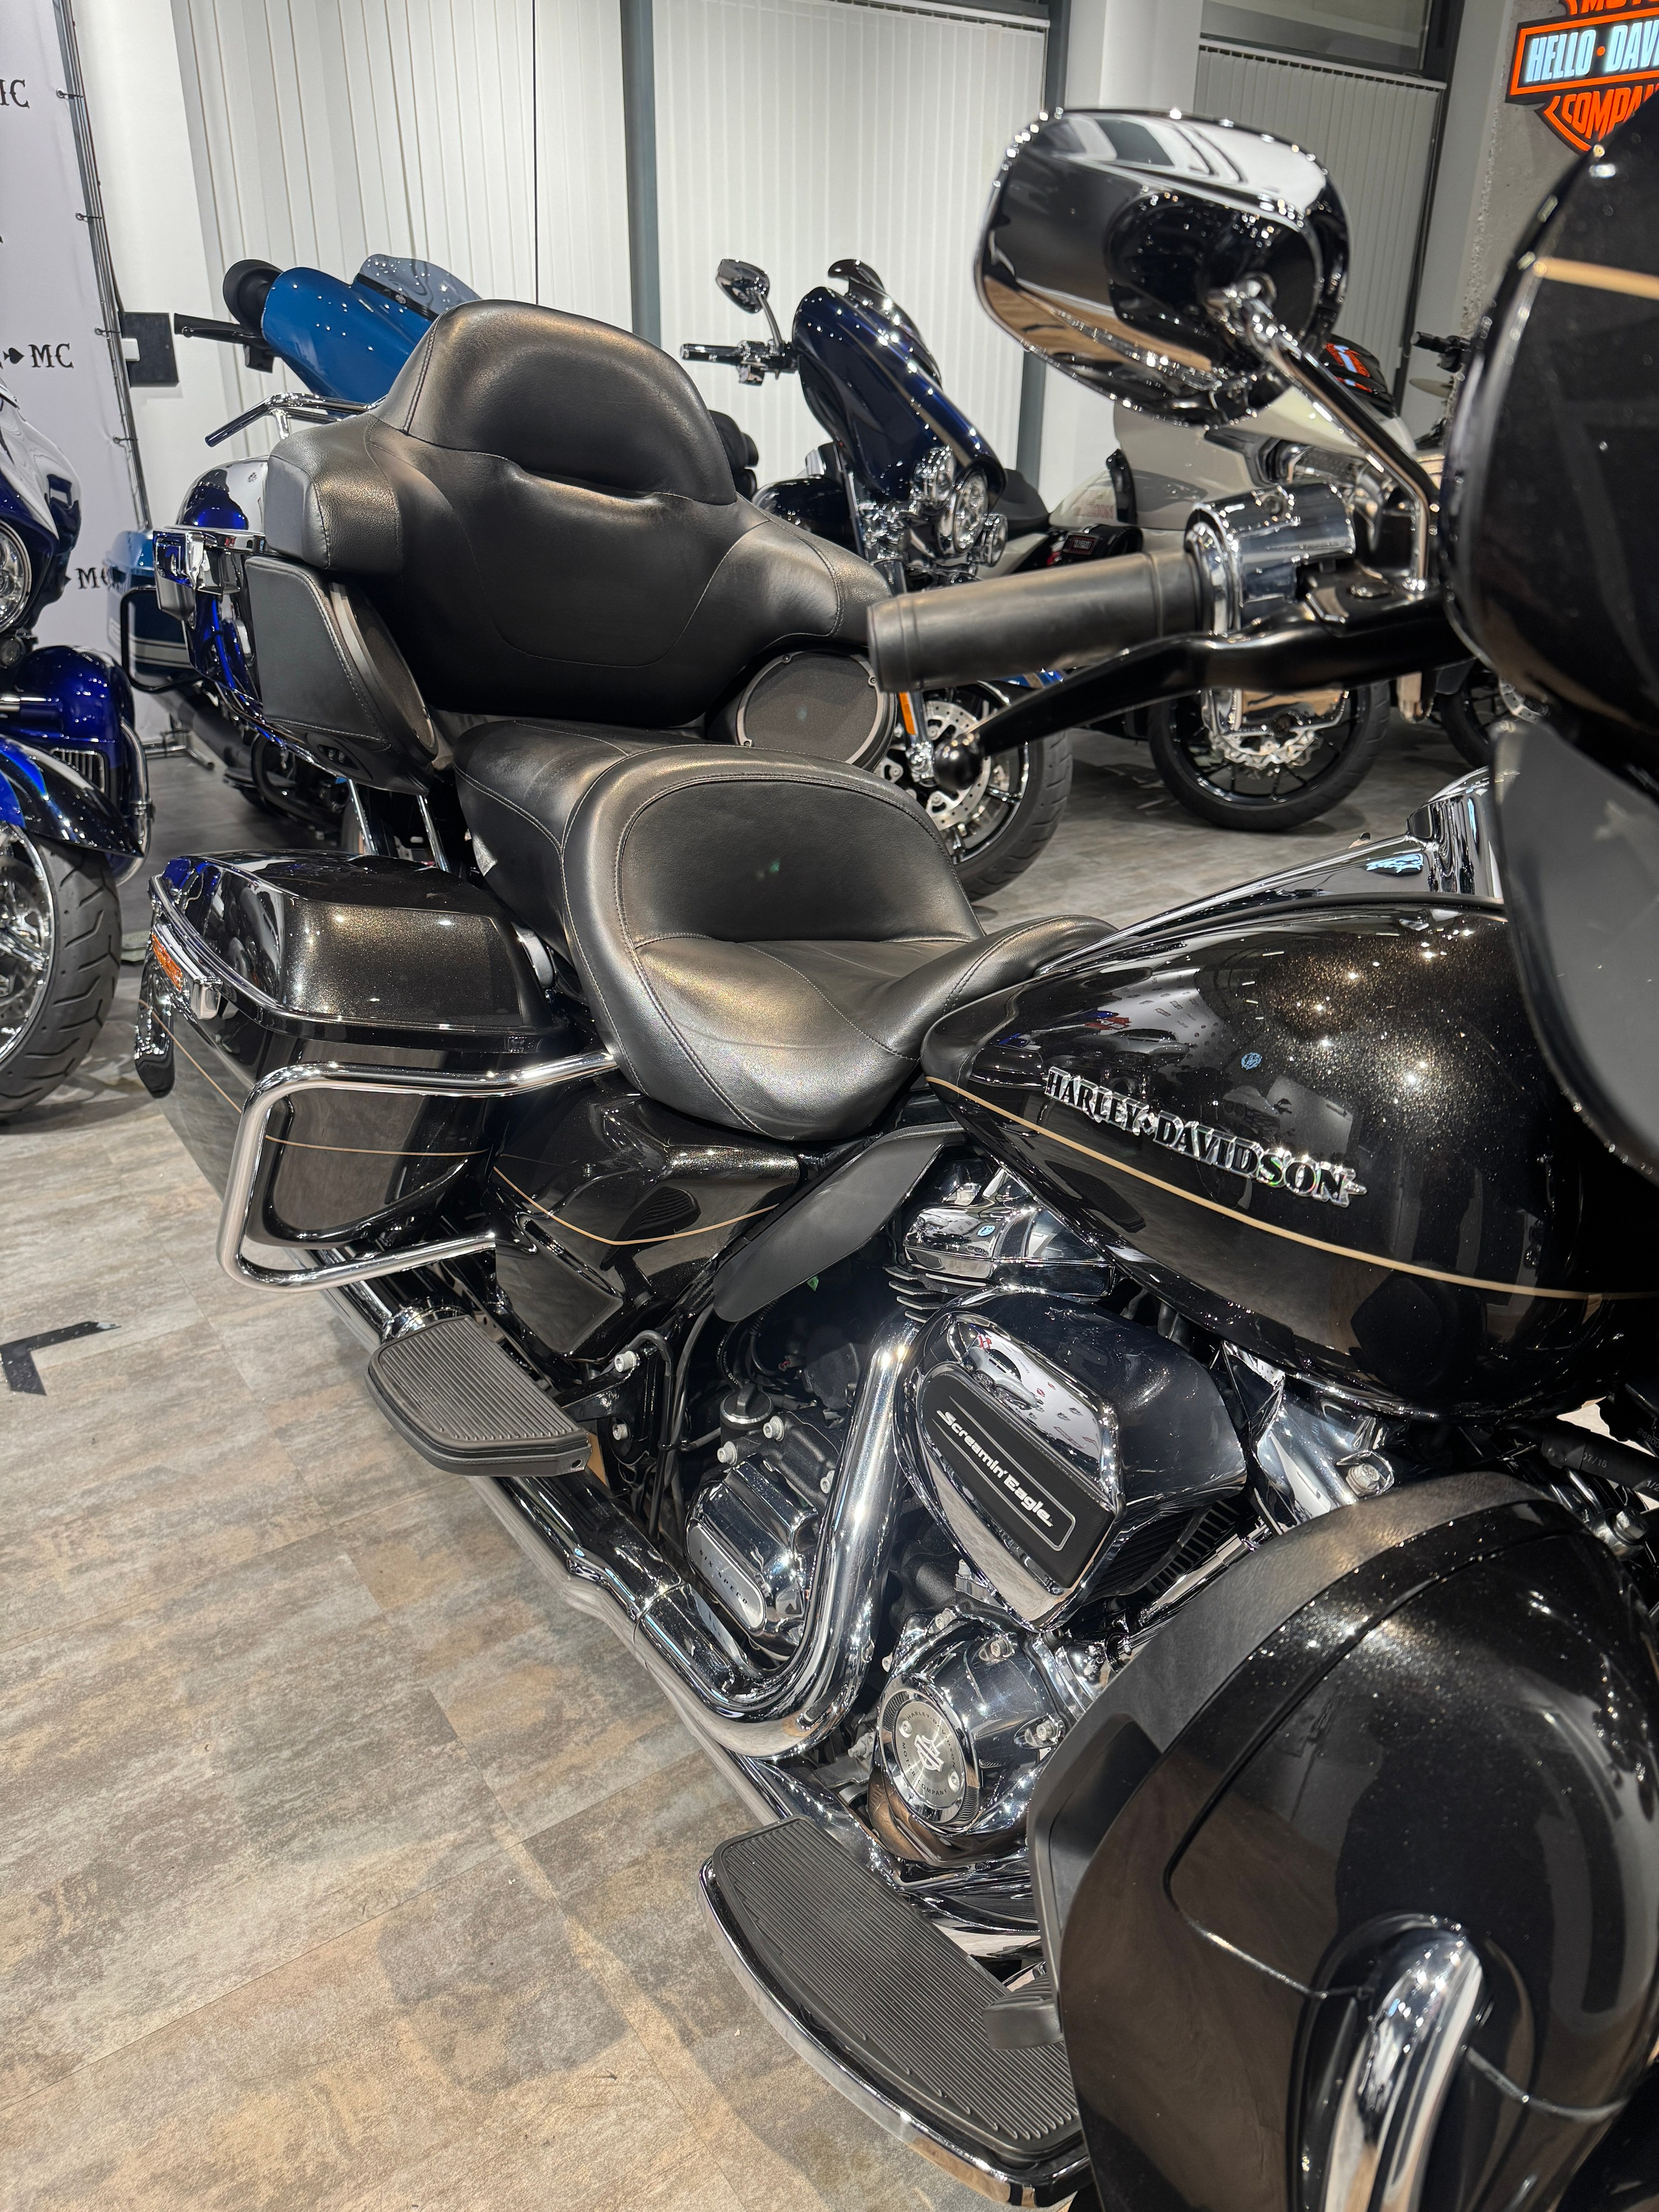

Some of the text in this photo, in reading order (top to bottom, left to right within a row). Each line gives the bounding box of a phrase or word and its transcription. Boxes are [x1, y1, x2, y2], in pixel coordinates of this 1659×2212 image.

[1527, 19, 1659, 83] HELLO DAV
[28, 343, 74, 369] MC
[1003, 1474, 1053, 1528] Eagle
[699, 1550, 713, 1568] SIX
